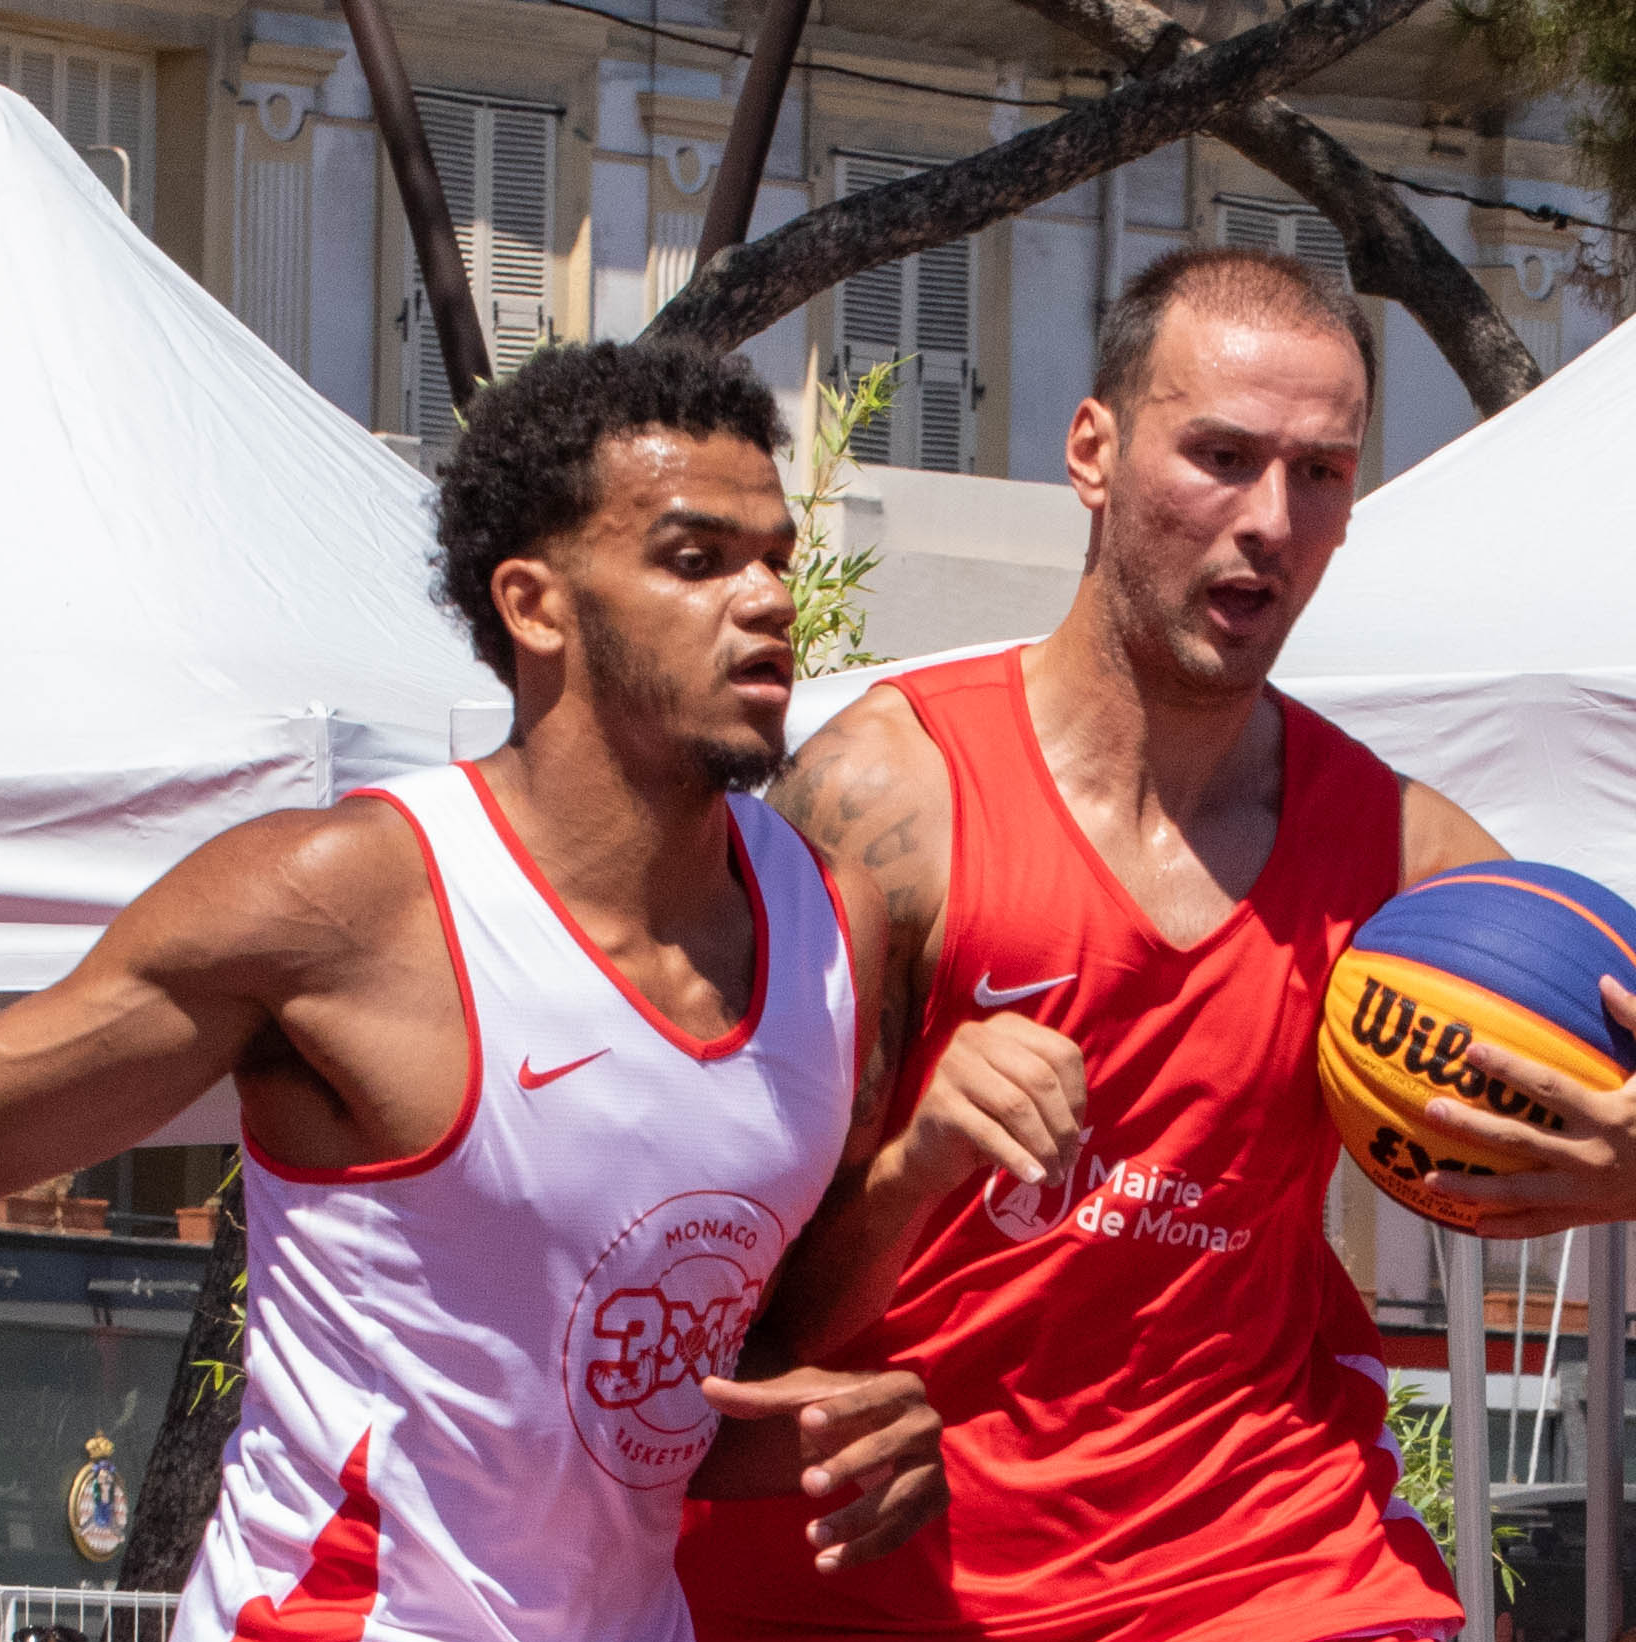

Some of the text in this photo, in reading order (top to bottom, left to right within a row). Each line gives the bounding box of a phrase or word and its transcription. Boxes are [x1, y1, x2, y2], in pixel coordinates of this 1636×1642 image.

[1087, 1153, 1204, 1208] Mairie
[664, 1219, 759, 1250] MONACO
[1076, 1196, 1125, 1238] de
